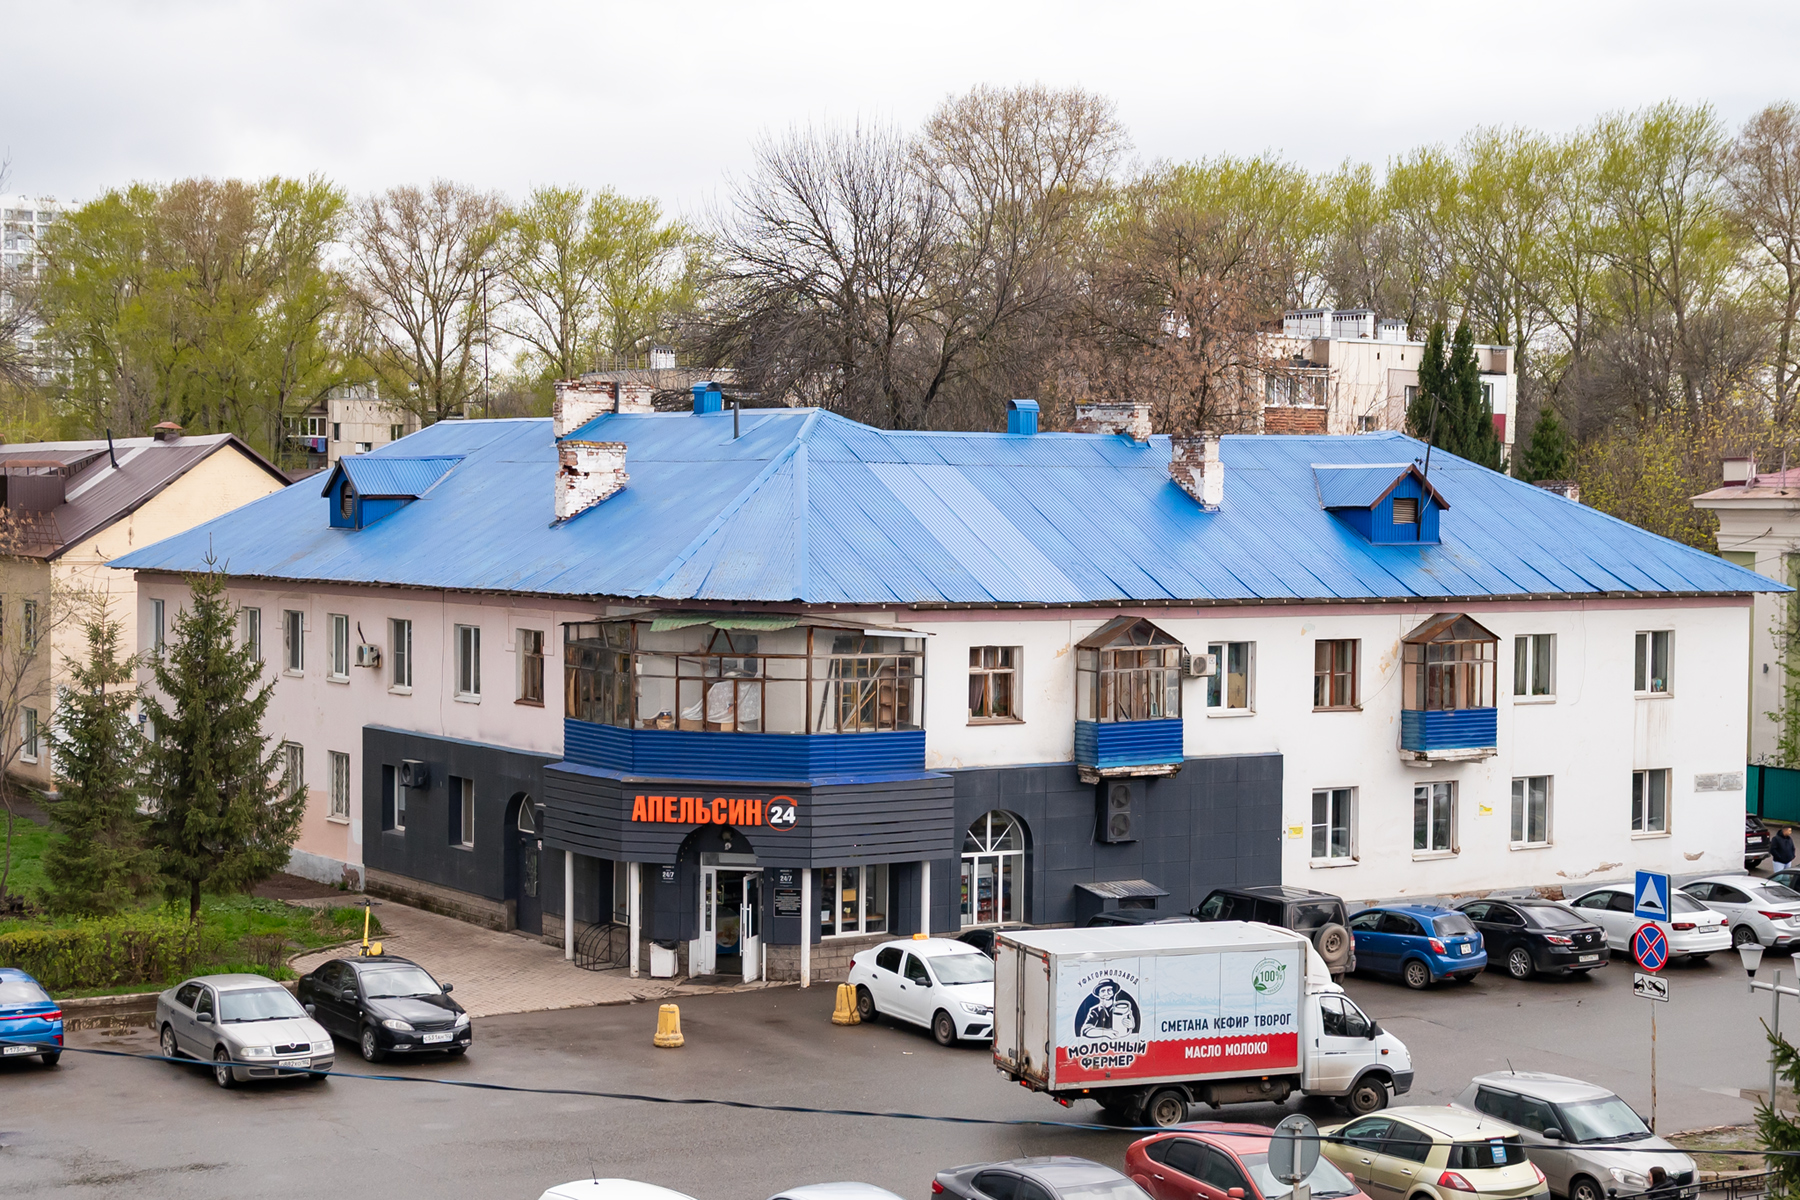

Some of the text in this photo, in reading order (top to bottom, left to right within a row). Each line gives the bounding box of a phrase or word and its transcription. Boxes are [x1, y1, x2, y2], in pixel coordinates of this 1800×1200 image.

[631, 795, 796, 826] АПЕЛЬСИН 24
[1077, 968, 1140, 988] УФАГОРМОЛЗАВОД
[1260, 970, 1283, 982] 100%
[1161, 1013, 1292, 1032] СМЕТАНА КЕФИР ТВОРОГ
[1068, 1040, 1146, 1058] МОЛОЧНЫЙ
[1185, 1041, 1268, 1059] МАСЛО МОЛОКО
[1081, 1054, 1134, 1069] ФЕРМЕР
